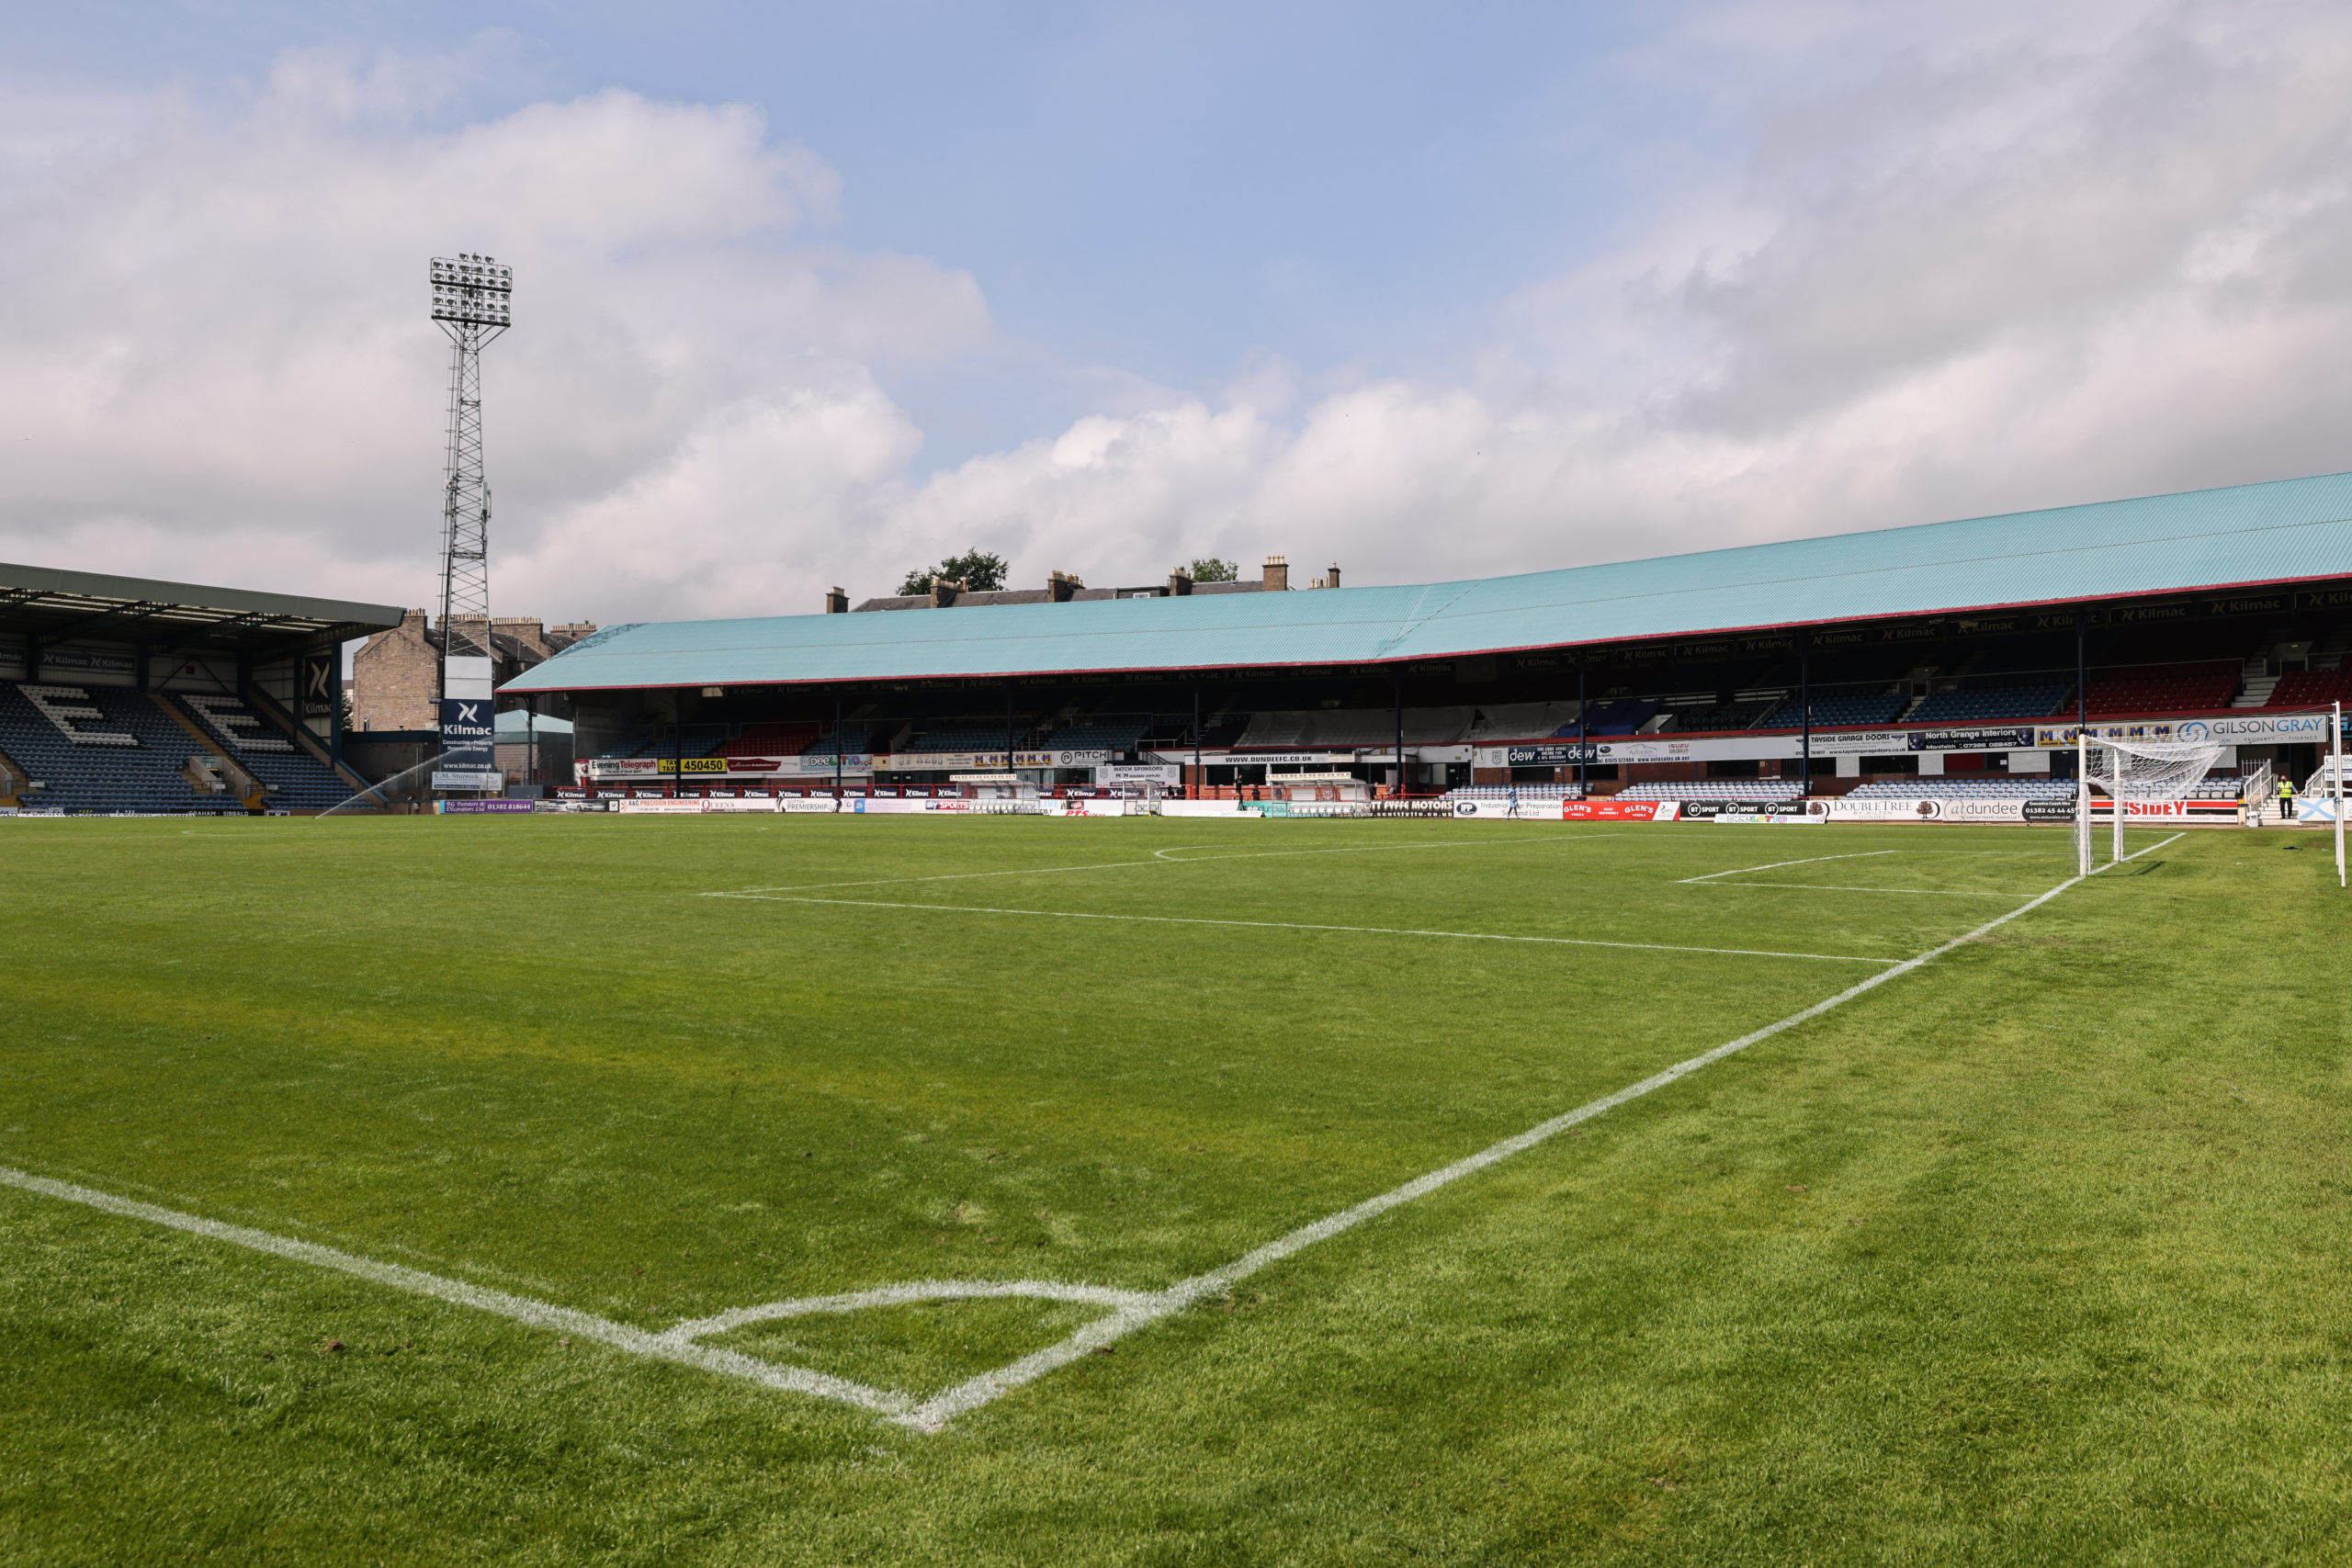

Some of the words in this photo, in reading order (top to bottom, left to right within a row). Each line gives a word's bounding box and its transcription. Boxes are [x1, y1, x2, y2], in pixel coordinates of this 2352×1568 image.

[2230, 599, 2280, 611] Kilmac
[2138, 607, 2186, 619] Kilmac
[2053, 614, 2097, 626] Kilac
[1973, 621, 2014, 632] Kilmac
[1897, 627, 1936, 638] Kilmac
[1826, 633, 1862, 643] Kilmac
[1759, 640, 1793, 649] Kilmac
[1635, 649, 1667, 659] Kilmac
[1695, 645, 1728, 655] Kilmac
[0, 653, 23, 661] lmac
[55, 656, 89, 666] Kilmac
[102, 660, 133, 669] Kilmac
[1420, 664, 1452, 673] Kilmac
[1245, 670, 1275, 678] Kilmac
[1302, 667, 1332, 676] Kilmac
[1079, 676, 1110, 684] Kilmac
[444, 724, 492, 735] Kilmac
[2085, 728, 2122, 738] MKM
[2130, 726, 2170, 738] MKM
[1950, 731, 1979, 739] Grange
[2040, 729, 2077, 742] MKM
[1509, 748, 1535, 761] dew
[1568, 746, 1595, 759] dew
[975, 755, 997, 764] MKM
[1028, 754, 1051, 762] MKM
[592, 761, 620, 770] Evening
[620, 760, 656, 770] Telegraph
[684, 760, 723, 770] 450450
[926, 801, 937, 809] sky
[1384, 801, 1409, 809] FYFFE
[1411, 800, 1453, 809] MOTORS
[1563, 804, 1592, 813] GLEN'S
[1624, 805, 1653, 813] GLEN'S
[1951, 802, 2018, 814] atdundee
[2129, 801, 2185, 815] SIDEY
